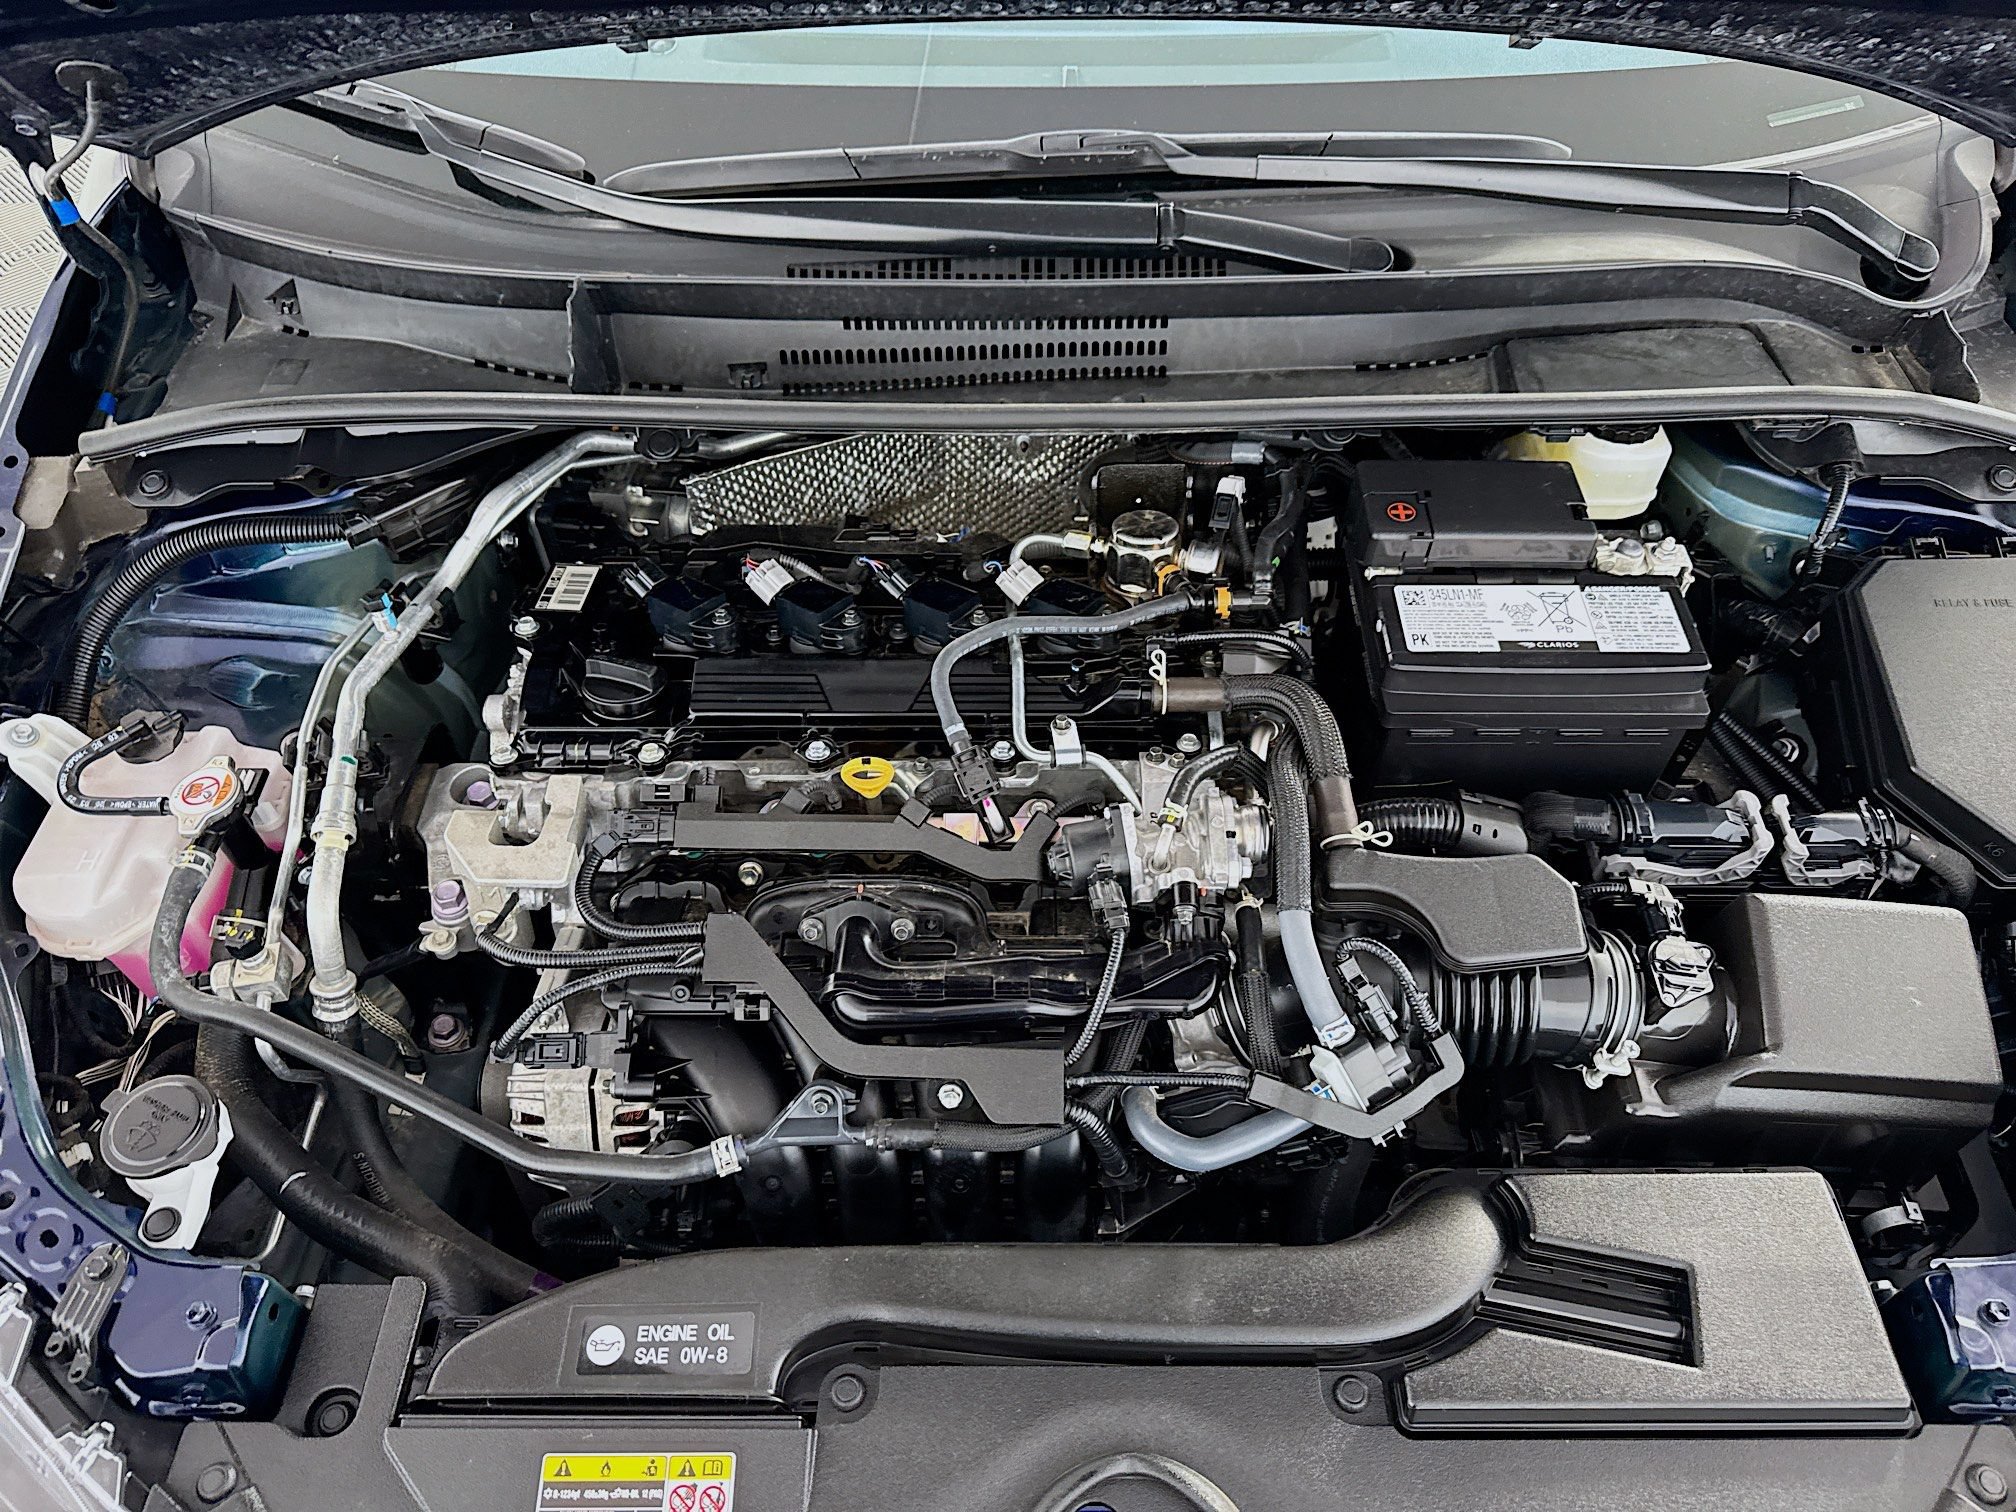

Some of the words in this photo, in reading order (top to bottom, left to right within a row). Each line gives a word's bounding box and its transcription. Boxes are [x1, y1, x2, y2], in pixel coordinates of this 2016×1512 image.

[1428, 588, 1483, 601] 345LN1-MF
[1556, 624, 1574, 634] Pb
[1411, 633, 1429, 646] PK
[107, 732, 119, 742] 03
[358, 1159, 391, 1203] NICHIRIN
[636, 1324, 698, 1342] ENGINE
[707, 1323, 735, 1341] OIL
[634, 1347, 669, 1365] SAE
[680, 1346, 728, 1364] 0W-8
